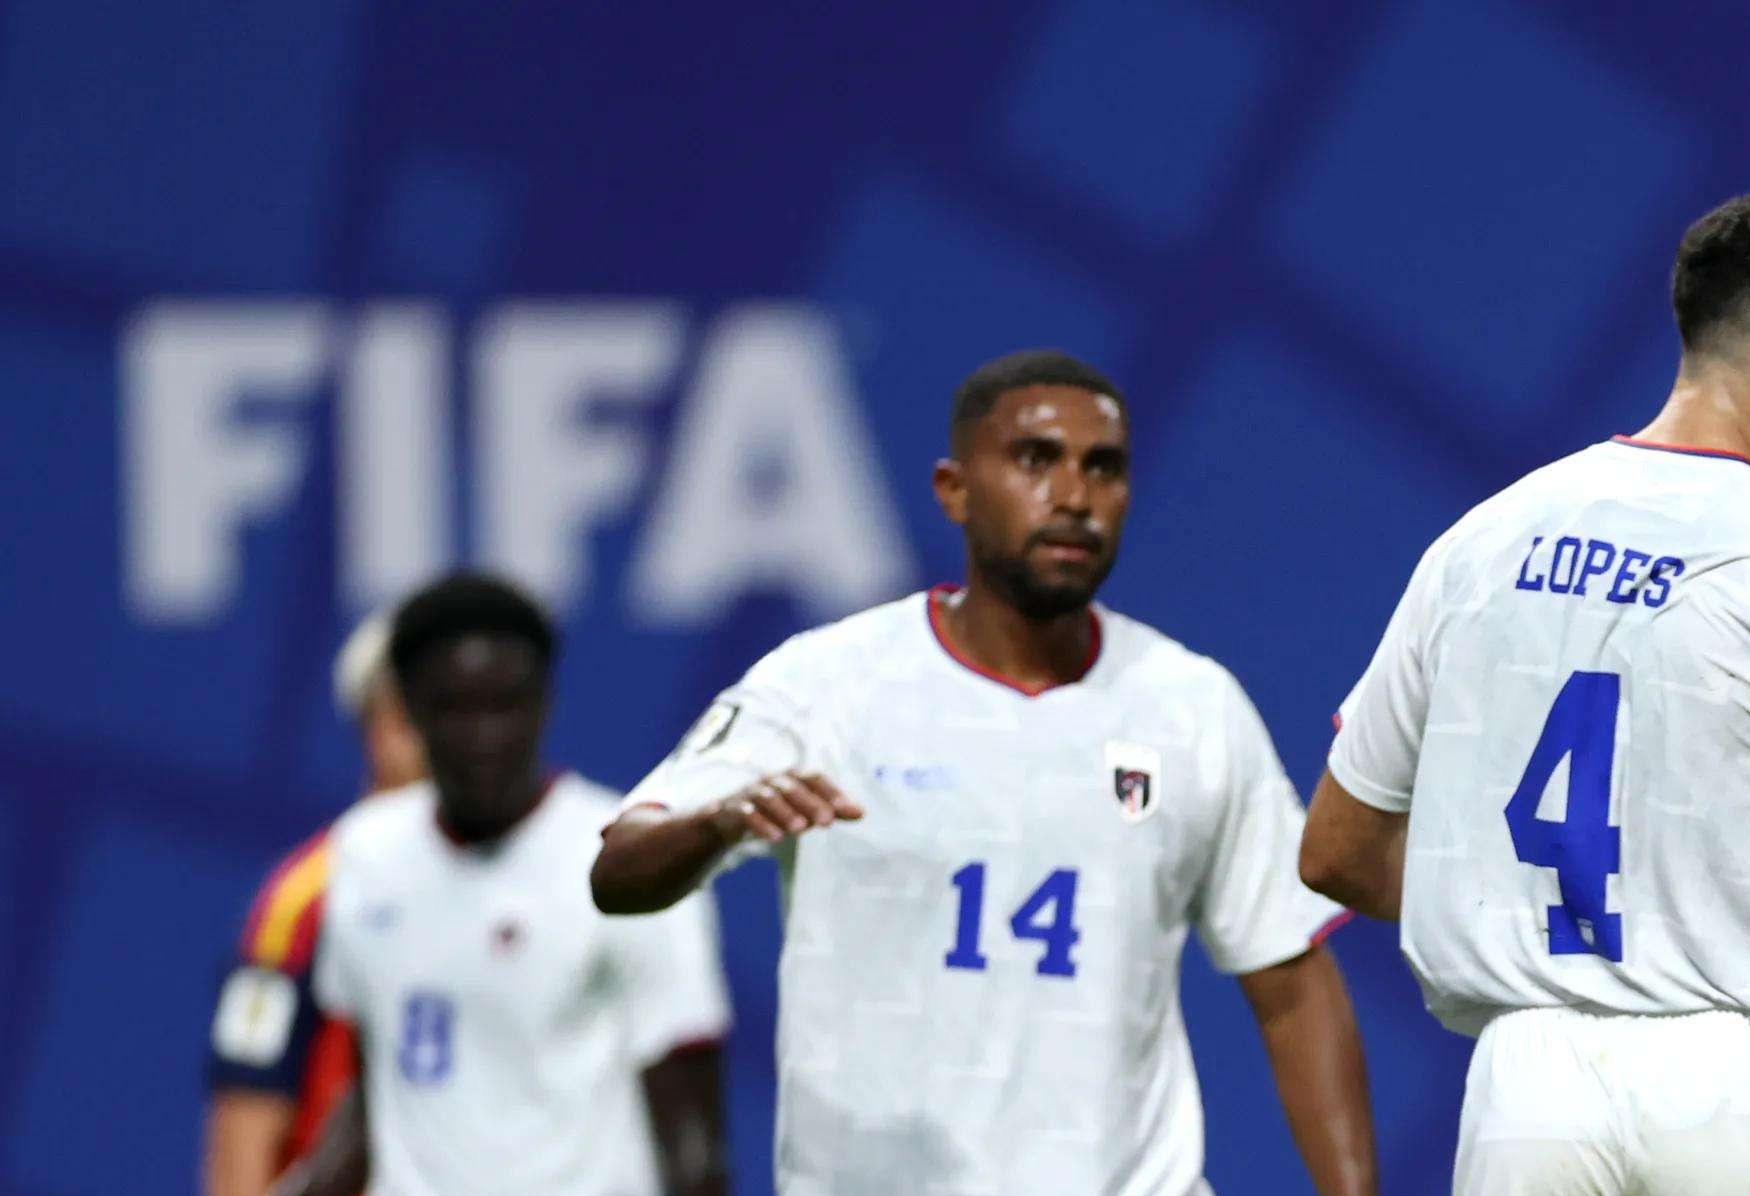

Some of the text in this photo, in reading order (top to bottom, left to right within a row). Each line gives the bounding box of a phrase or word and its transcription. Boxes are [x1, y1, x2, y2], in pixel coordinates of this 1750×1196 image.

[123, 304, 908, 626] FIFA
[1515, 536, 1686, 609] LOPES
[1504, 670, 1623, 963] 4
[944, 861, 1081, 978] 14
[397, 988, 458, 1088] 8
